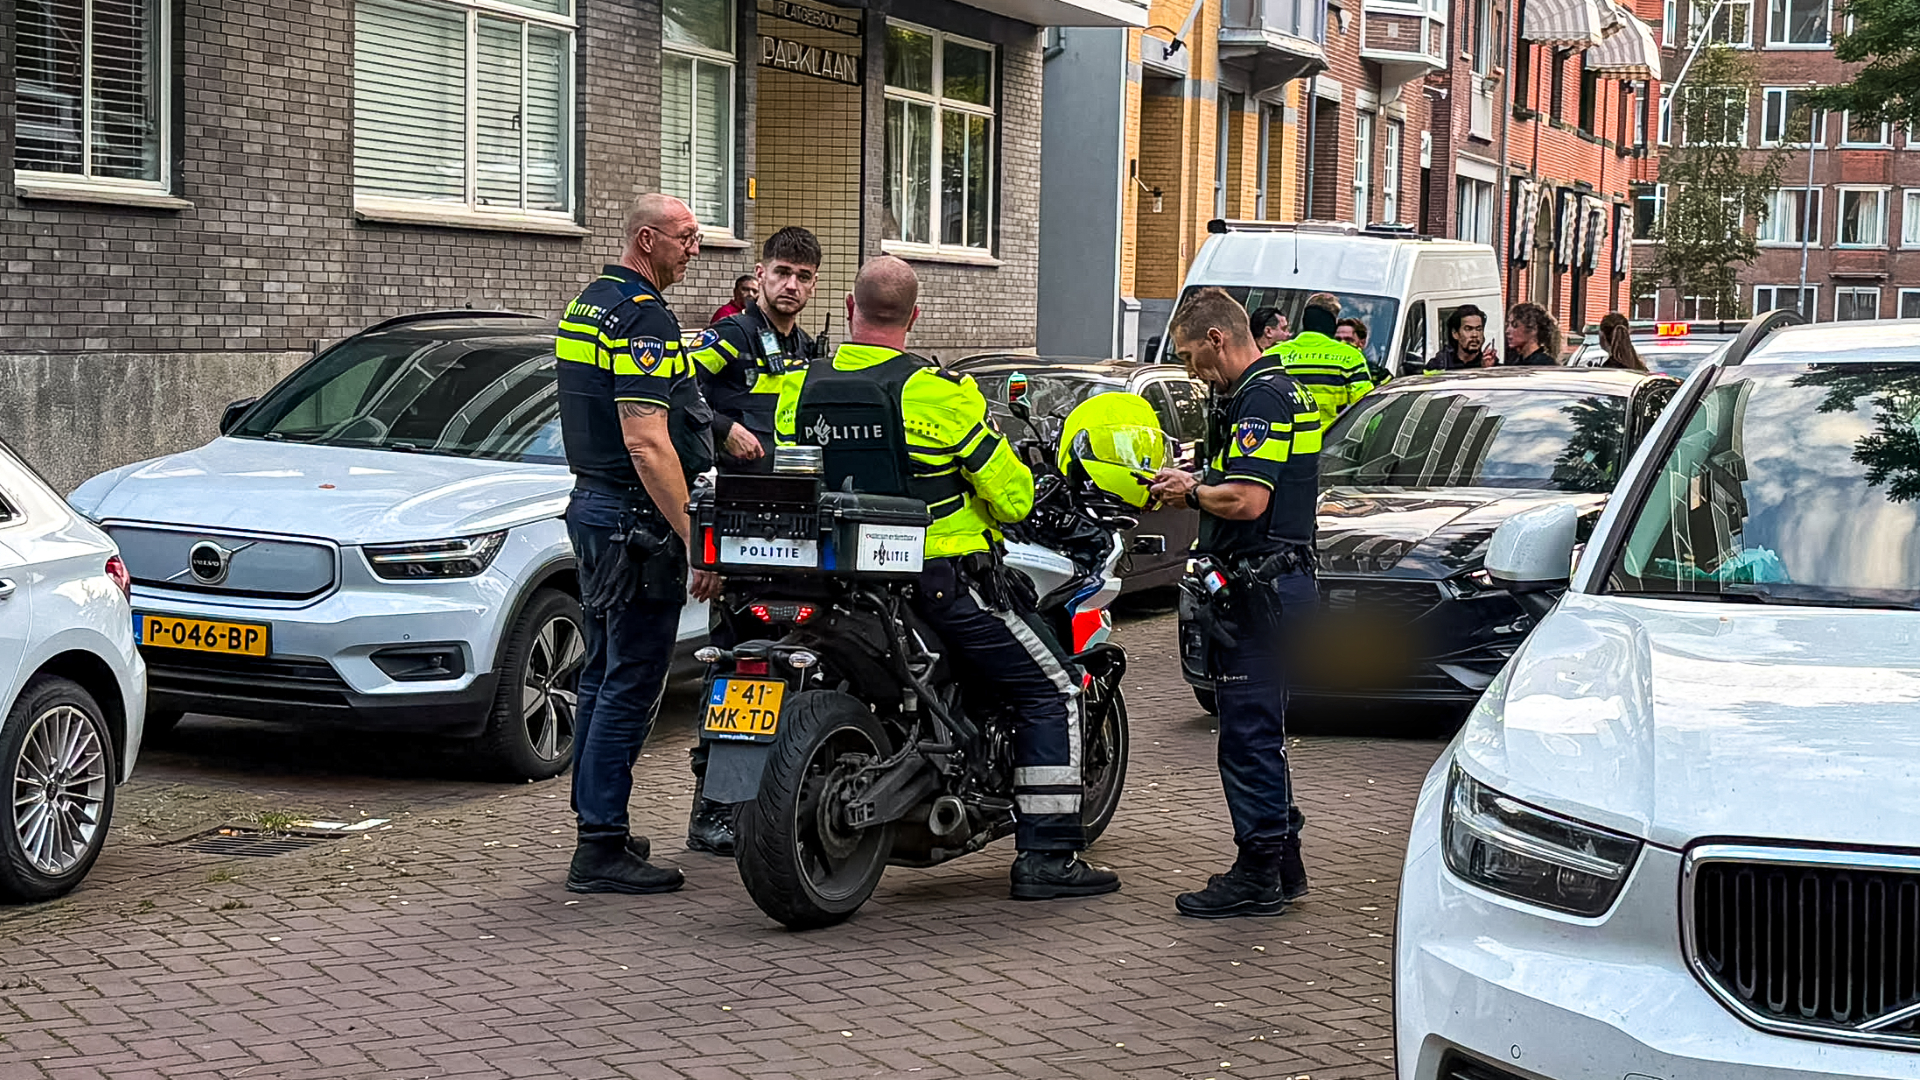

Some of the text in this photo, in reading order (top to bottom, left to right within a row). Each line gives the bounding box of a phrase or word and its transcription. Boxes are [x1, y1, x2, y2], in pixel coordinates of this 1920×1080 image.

[777, 2, 842, 29] FLATGEBOUW
[763, 36, 858, 83] PARKLAAN
[805, 417, 883, 445] POLITIE
[193, 559, 220, 567] VOLVO
[740, 545, 800, 559] POLITIE
[873, 543, 909, 566] POLITIE
[150, 619, 259, 651] P-046-BP
[742, 684, 765, 705] 41
